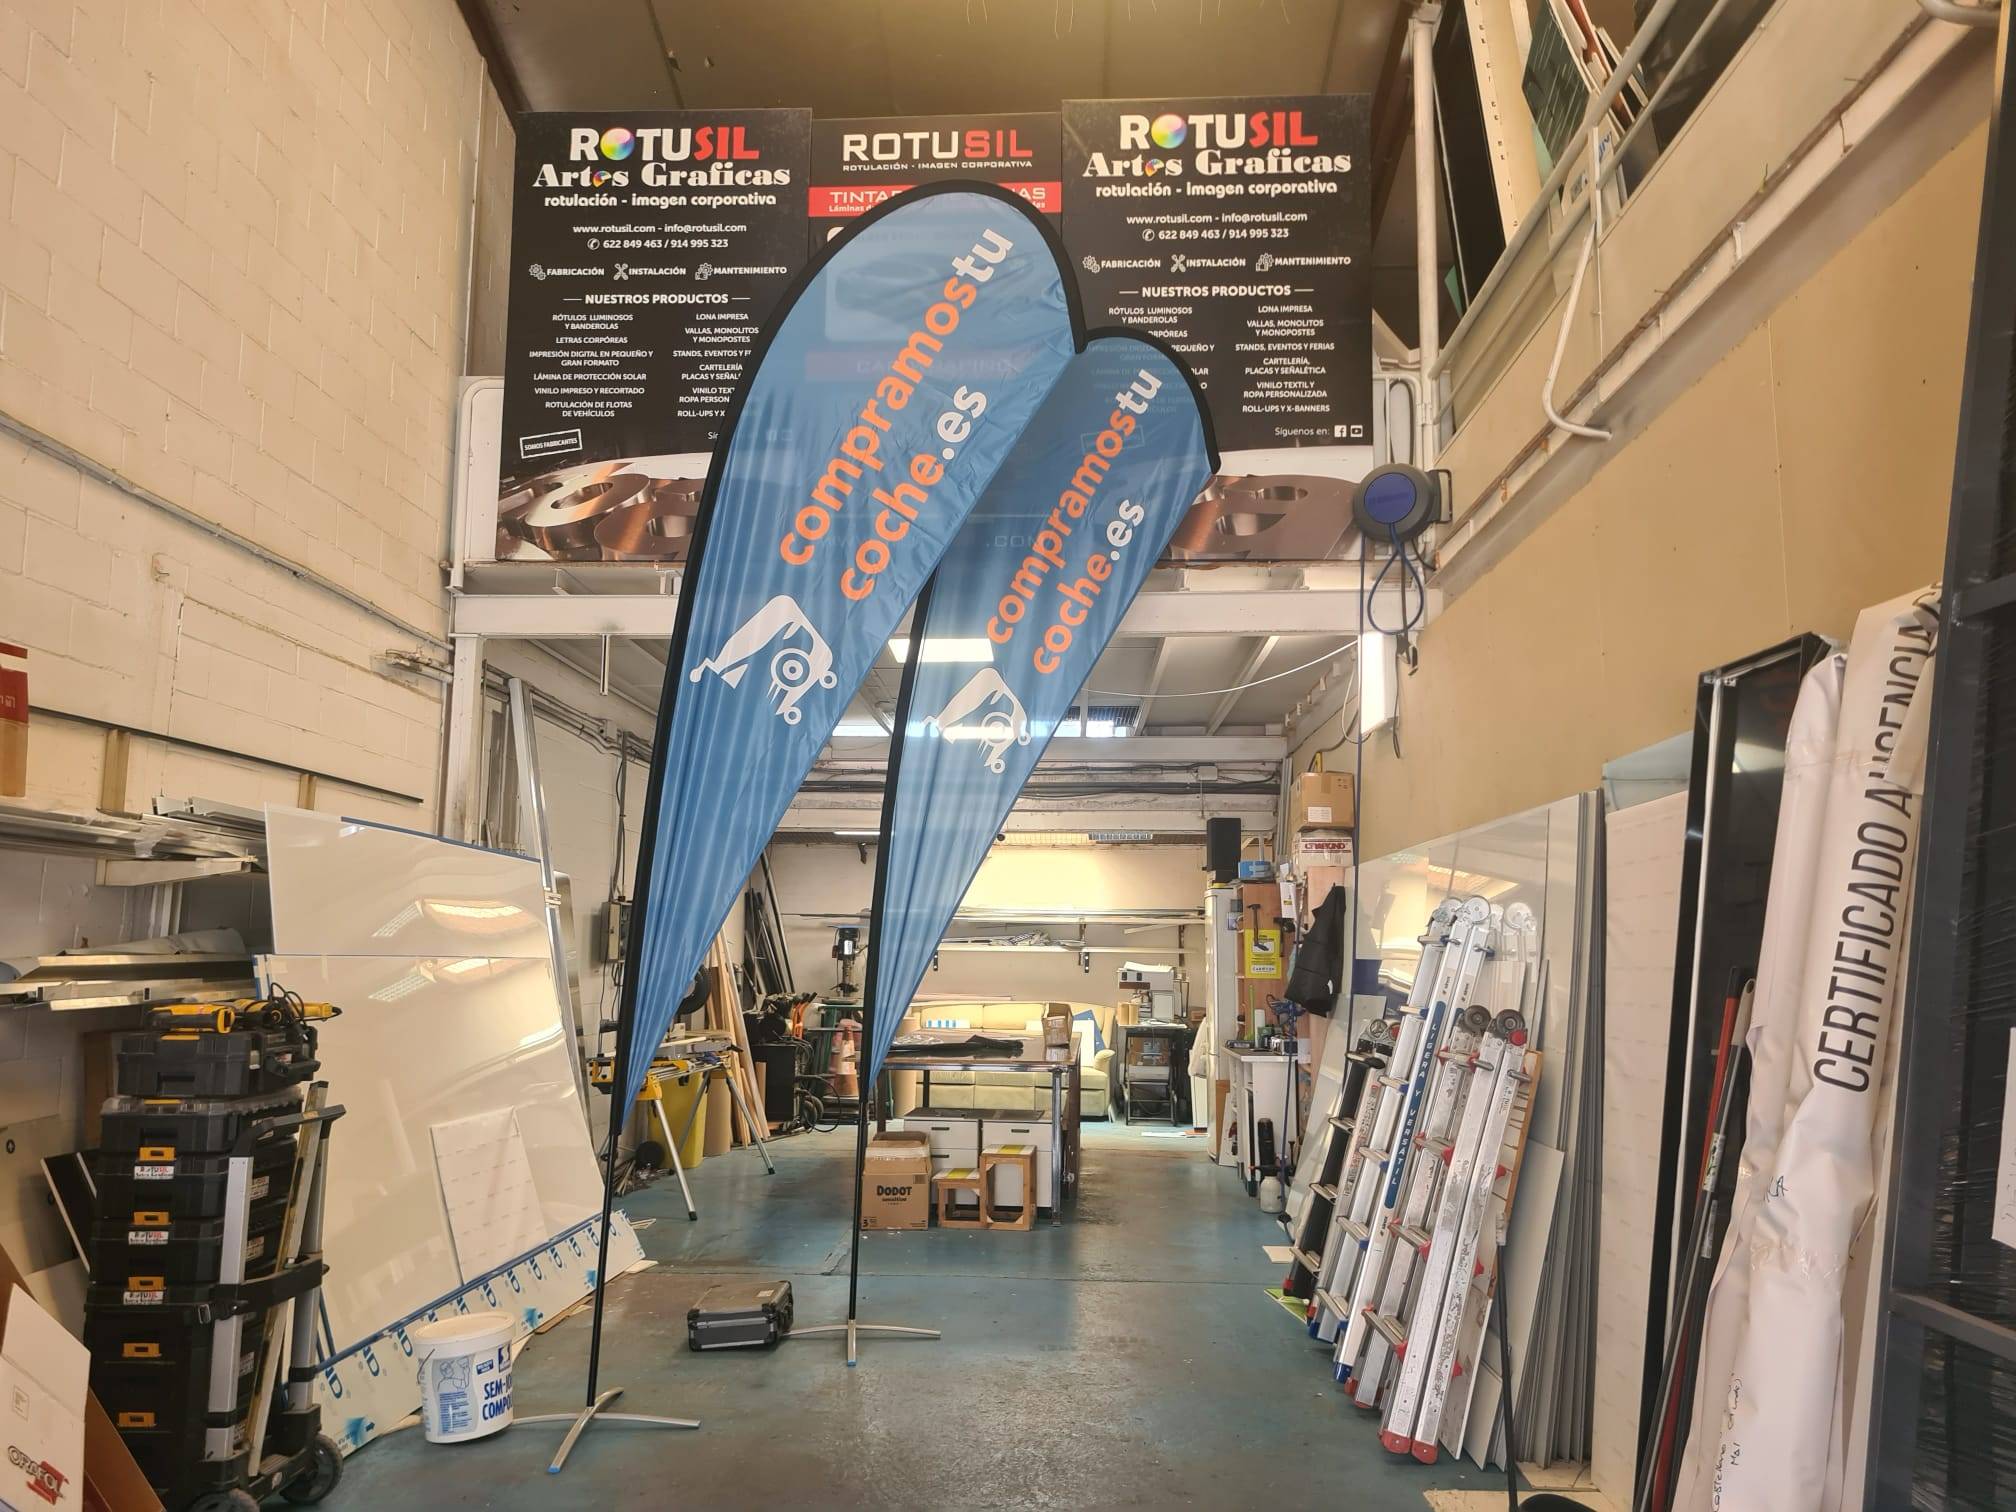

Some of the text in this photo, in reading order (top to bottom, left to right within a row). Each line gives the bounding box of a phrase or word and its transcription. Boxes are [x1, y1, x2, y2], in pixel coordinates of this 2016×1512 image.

[1119, 111, 1318, 150] ROTUSIL
[569, 126, 760, 161] ROTUSIL
[843, 129, 1033, 162] ROTUSIL
[843, 163, 909, 172] ROTULACIÓN
[962, 161, 1032, 169] CORPORATIVA
[1082, 148, 1351, 178] Artes Graficas
[532, 162, 790, 187] Artes Graficas
[1096, 182, 1171, 197] rotulación
[1186, 182, 1244, 199] imagen
[1249, 180, 1337, 198] corporativa
[544, 193, 617, 207] rotulación
[631, 193, 687, 209] imagen
[691, 193, 776, 209] corporativa
[1126, 213, 1212, 225] www.rotusil.com
[1222, 212, 1308, 224] info@rotusil.com
[573, 224, 656, 234] www.rotusil.com
[664, 223, 747, 234] info@rotusil.com
[1158, 230, 1178, 240] 622
[1180, 230, 1199, 240] 849
[1201, 229, 1220, 239] 463
[1229, 229, 1248, 239] 914
[1249, 229, 1269, 239] 995
[1270, 228, 1289, 238] 323
[603, 240, 623, 249] 622
[623, 240, 642, 249] 849
[644, 240, 663, 249] 463
[670, 239, 688, 249] 914
[689, 239, 708, 248] 995
[710, 239, 729, 248] 323
[1101, 256, 1351, 269] FABRICACIÓN INSTALACIÓN MANTENIMIENTO
[547, 265, 787, 276] FABRICACIÓN INSTALACIÓN MANTENIMIENTO
[1142, 285, 1291, 298] NUESTROS PRODUCTOS
[585, 294, 729, 304] NUESTROS PRODUCTOS
[1108, 306, 1145, 315] RÓTULOS
[1280, 305, 1313, 313] IMPRESA
[552, 313, 586, 321] RÓTULOS
[1128, 316, 1178, 324] BANDEROLAS
[1277, 319, 1324, 327] MONOLITOS
[583, 335, 628, 344] CORPÓREAS
[1267, 343, 1303, 351] EVENTOS
[529, 350, 569, 358] IMPRESIÓN
[611, 350, 647, 358] PEQUEÑO
[533, 372, 561, 380] LÁMINA
[715, 372, 741, 380] SEÑAL
[1245, 367, 1274, 375] PLACAS
[1280, 366, 1326, 375] SEÑALÉTICA
[780, 228, 1014, 566] compramostu
[1265, 390, 1327, 398] PERSONALIZADA
[1242, 405, 1279, 413] ROLL-UPS
[840, 385, 987, 601] coche.es
[987, 369, 1163, 644] compramostu
[1033, 500, 1145, 674] coche.es
[1813, 821, 1910, 1094] CERTIFICADO
[1418, 1023, 1437, 1078] LIGERA
